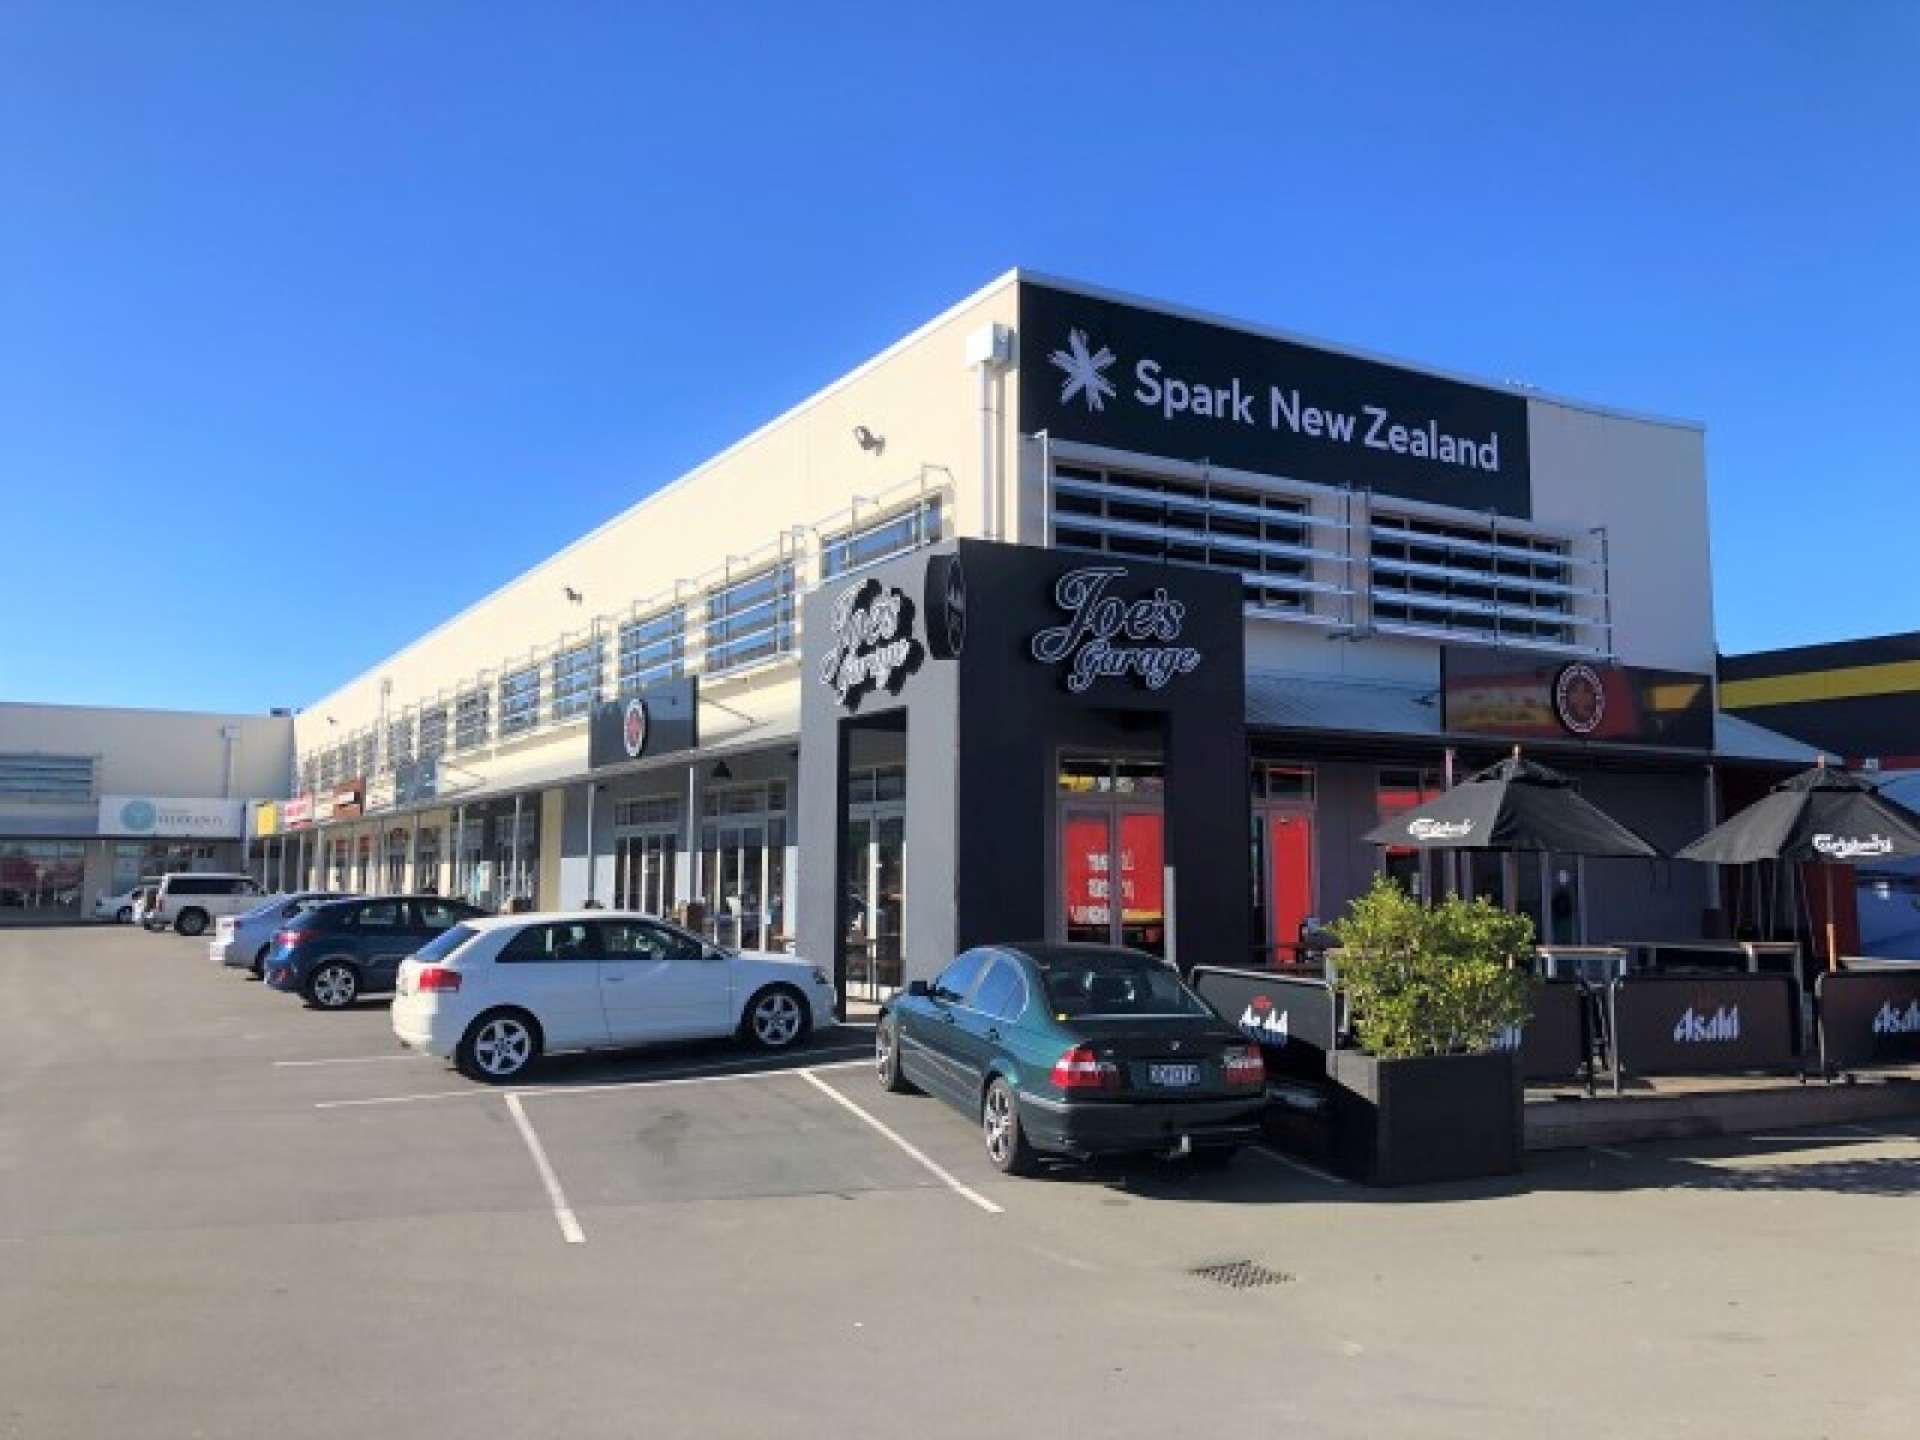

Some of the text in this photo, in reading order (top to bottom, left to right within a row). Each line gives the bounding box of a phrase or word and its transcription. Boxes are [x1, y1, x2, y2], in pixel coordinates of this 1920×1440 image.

[1134, 358, 1499, 472] Spark New Zealand
[1032, 566, 1186, 664] Joe's
[1067, 637, 1202, 692] Garage
[1673, 1003, 1739, 1042] Asahi
